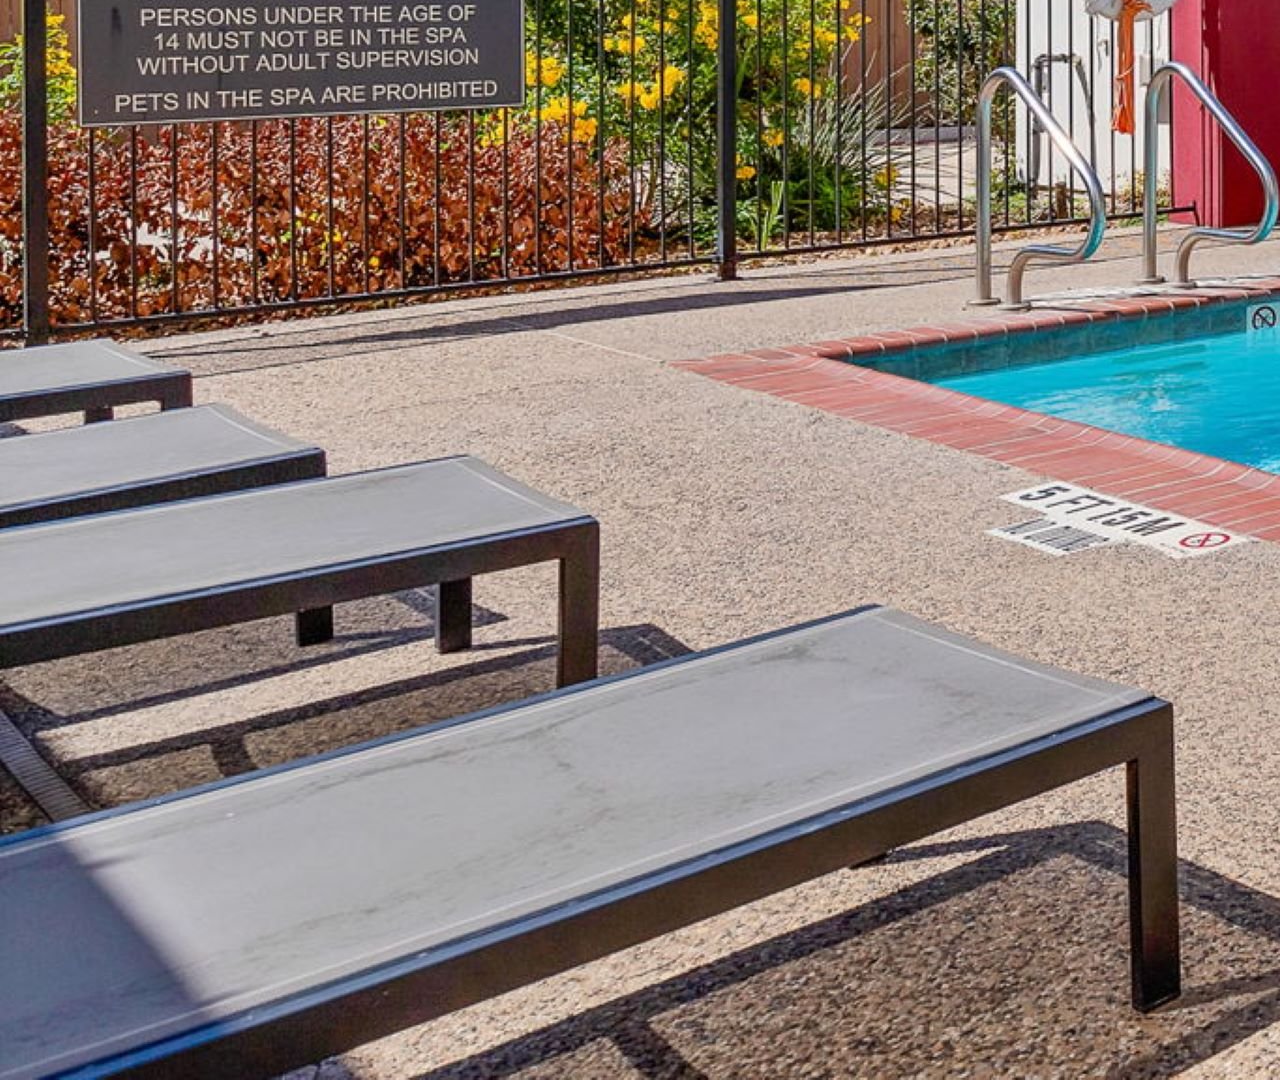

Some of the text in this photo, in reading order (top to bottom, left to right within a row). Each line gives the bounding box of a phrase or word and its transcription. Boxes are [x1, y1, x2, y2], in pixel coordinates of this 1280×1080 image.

[141, 5, 476, 27] PERSONS UNDER THE AGE OF
[155, 27, 467, 51] 14 MUST NOT BE IN THE SPA
[136, 48, 479, 75] WITHOUT ADULT SUPERVISION
[115, 80, 498, 113] PETS IN THE SPA ARE PROHIBITED
[1019, 485, 1070, 501] 5
[1046, 494, 1115, 514] FT
